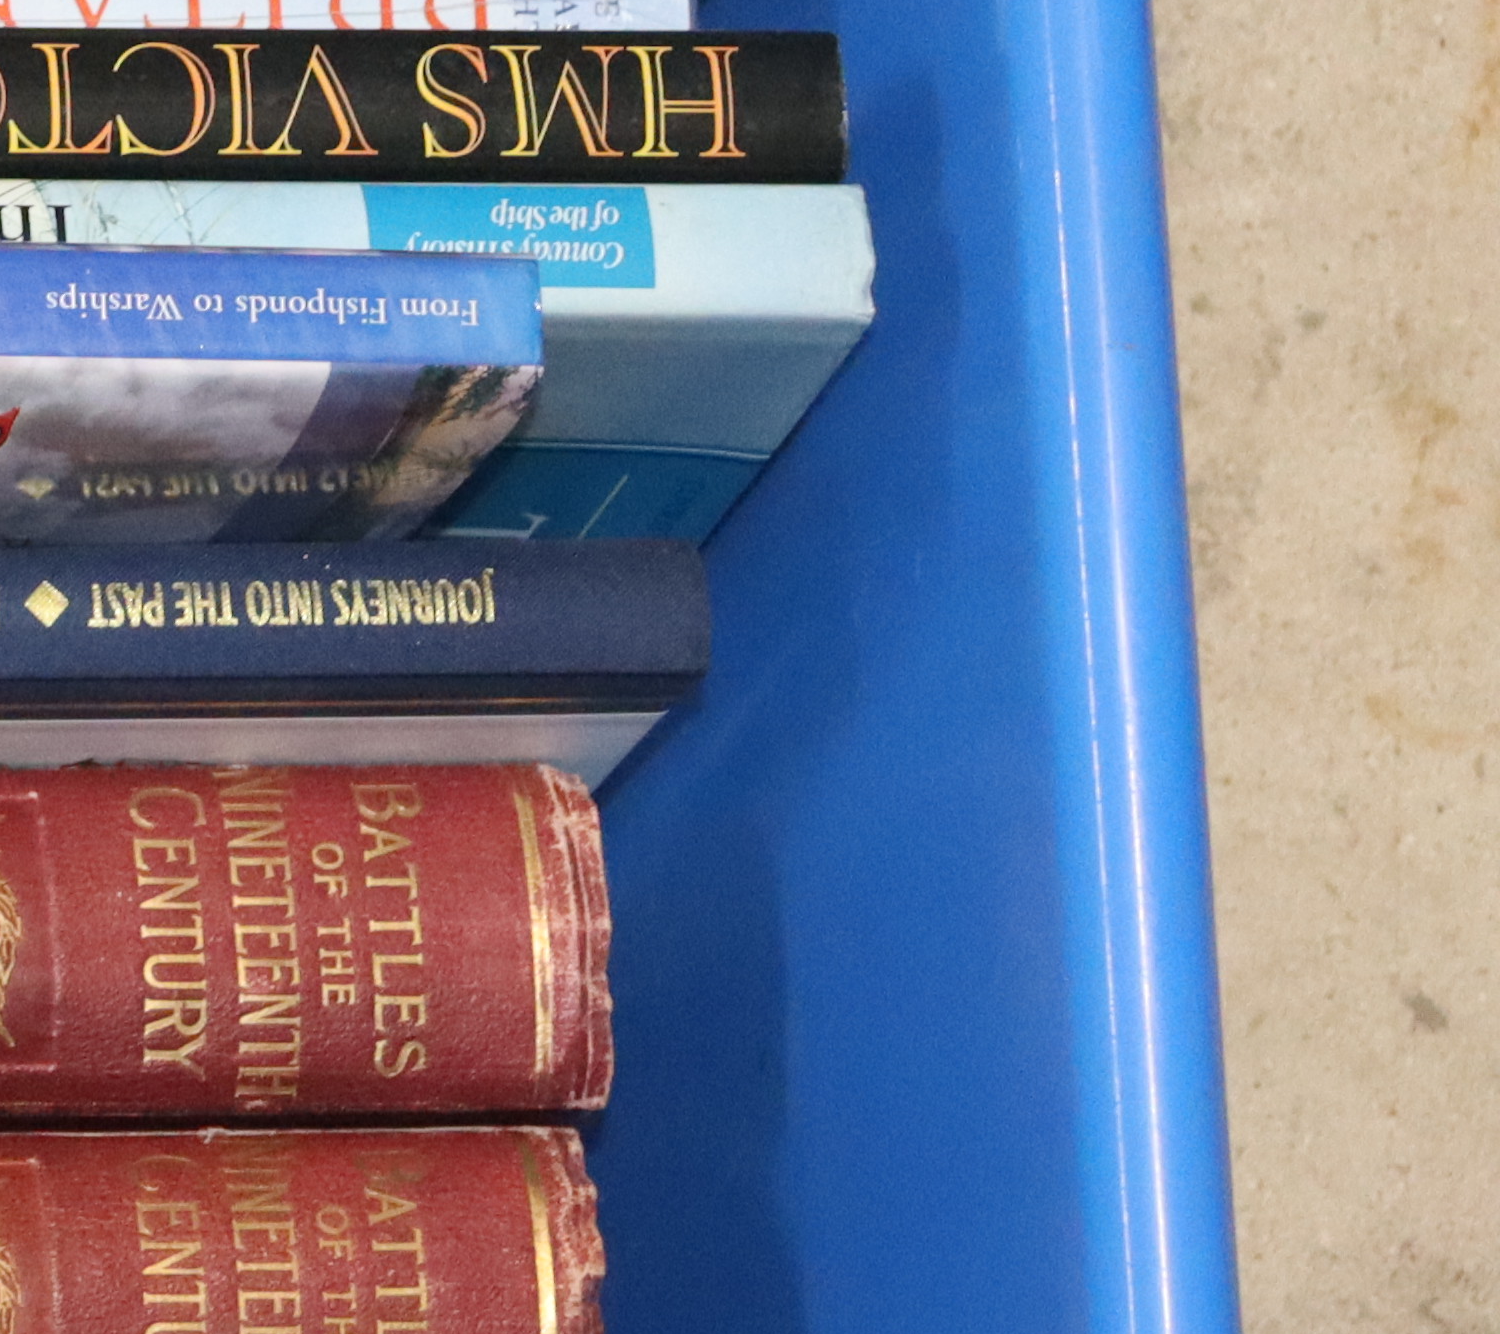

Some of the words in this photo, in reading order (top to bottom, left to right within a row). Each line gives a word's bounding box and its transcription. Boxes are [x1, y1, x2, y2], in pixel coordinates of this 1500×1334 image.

[417, 44, 745, 157] HMS
[46, 284, 182, 320] Warships
[194, 292, 224, 320] to
[236, 288, 386, 324] Fishponds
[402, 299, 477, 326] From
[88, 583, 164, 627] PAST
[173, 583, 238, 626] THE
[247, 582, 323, 626] INTO
[331, 569, 494, 625] JOURNEYS
[312, 844, 347, 897] OF
[130, 785, 208, 1082] CENTURY
[212, 766, 300, 1100] NINETEENTH
[351, 781, 425, 1078] BATTLES
[318, 918, 355, 1006] THE
